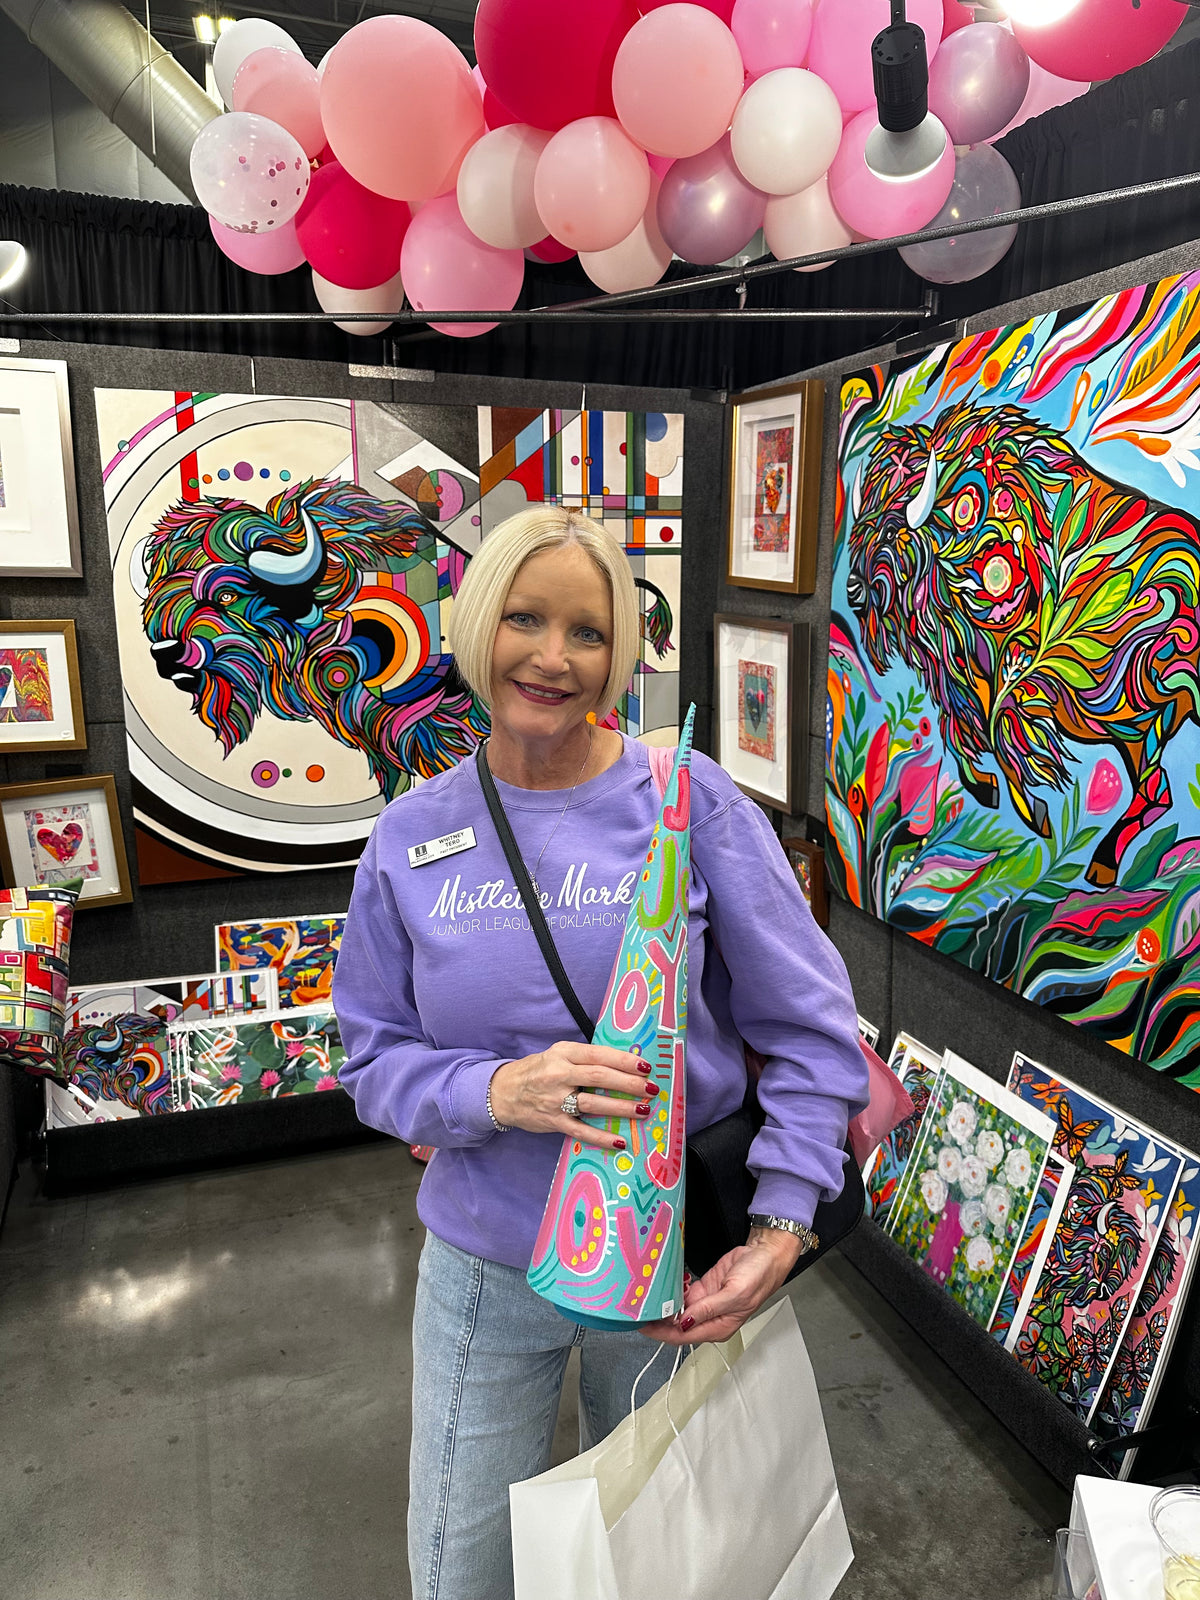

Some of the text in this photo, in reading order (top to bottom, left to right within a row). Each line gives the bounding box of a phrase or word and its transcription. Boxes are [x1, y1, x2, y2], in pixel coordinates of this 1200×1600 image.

[438, 832, 464, 844] WHITNEY
[445, 838, 460, 847] TERO
[428, 874, 553, 920] Mistlete
[427, 919, 481, 936] JUNIOR
[485, 916, 534, 931] LEAGU
[560, 912, 627, 929] OKLAHOM
